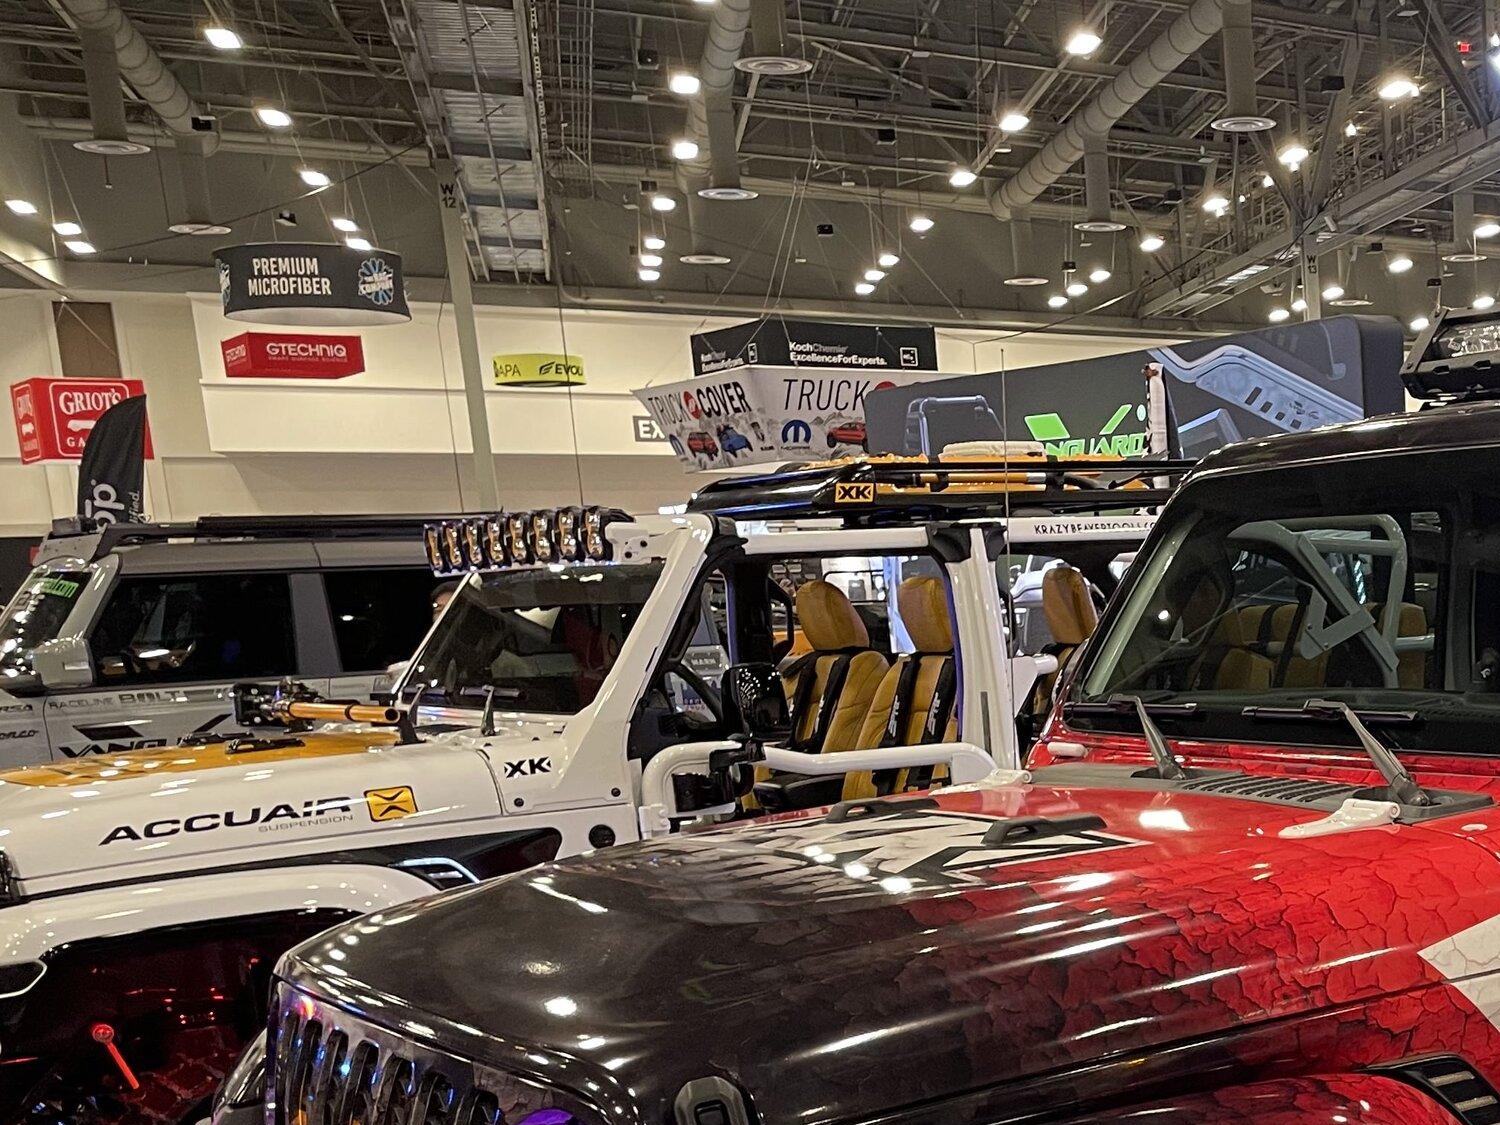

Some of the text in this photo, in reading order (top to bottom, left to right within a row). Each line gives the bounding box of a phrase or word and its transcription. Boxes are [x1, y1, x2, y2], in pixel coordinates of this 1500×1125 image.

[442, 197, 456, 208] 12
[252, 257, 319, 276] PREMIUM
[248, 277, 332, 296] MICROFIBER
[698, 381, 752, 418] COVER
[782, 378, 871, 411] TRUCK
[838, 485, 871, 500] XK
[504, 756, 552, 779] XK
[98, 796, 352, 847] ACCUAIR
[257, 814, 354, 833] SUSPENSION
